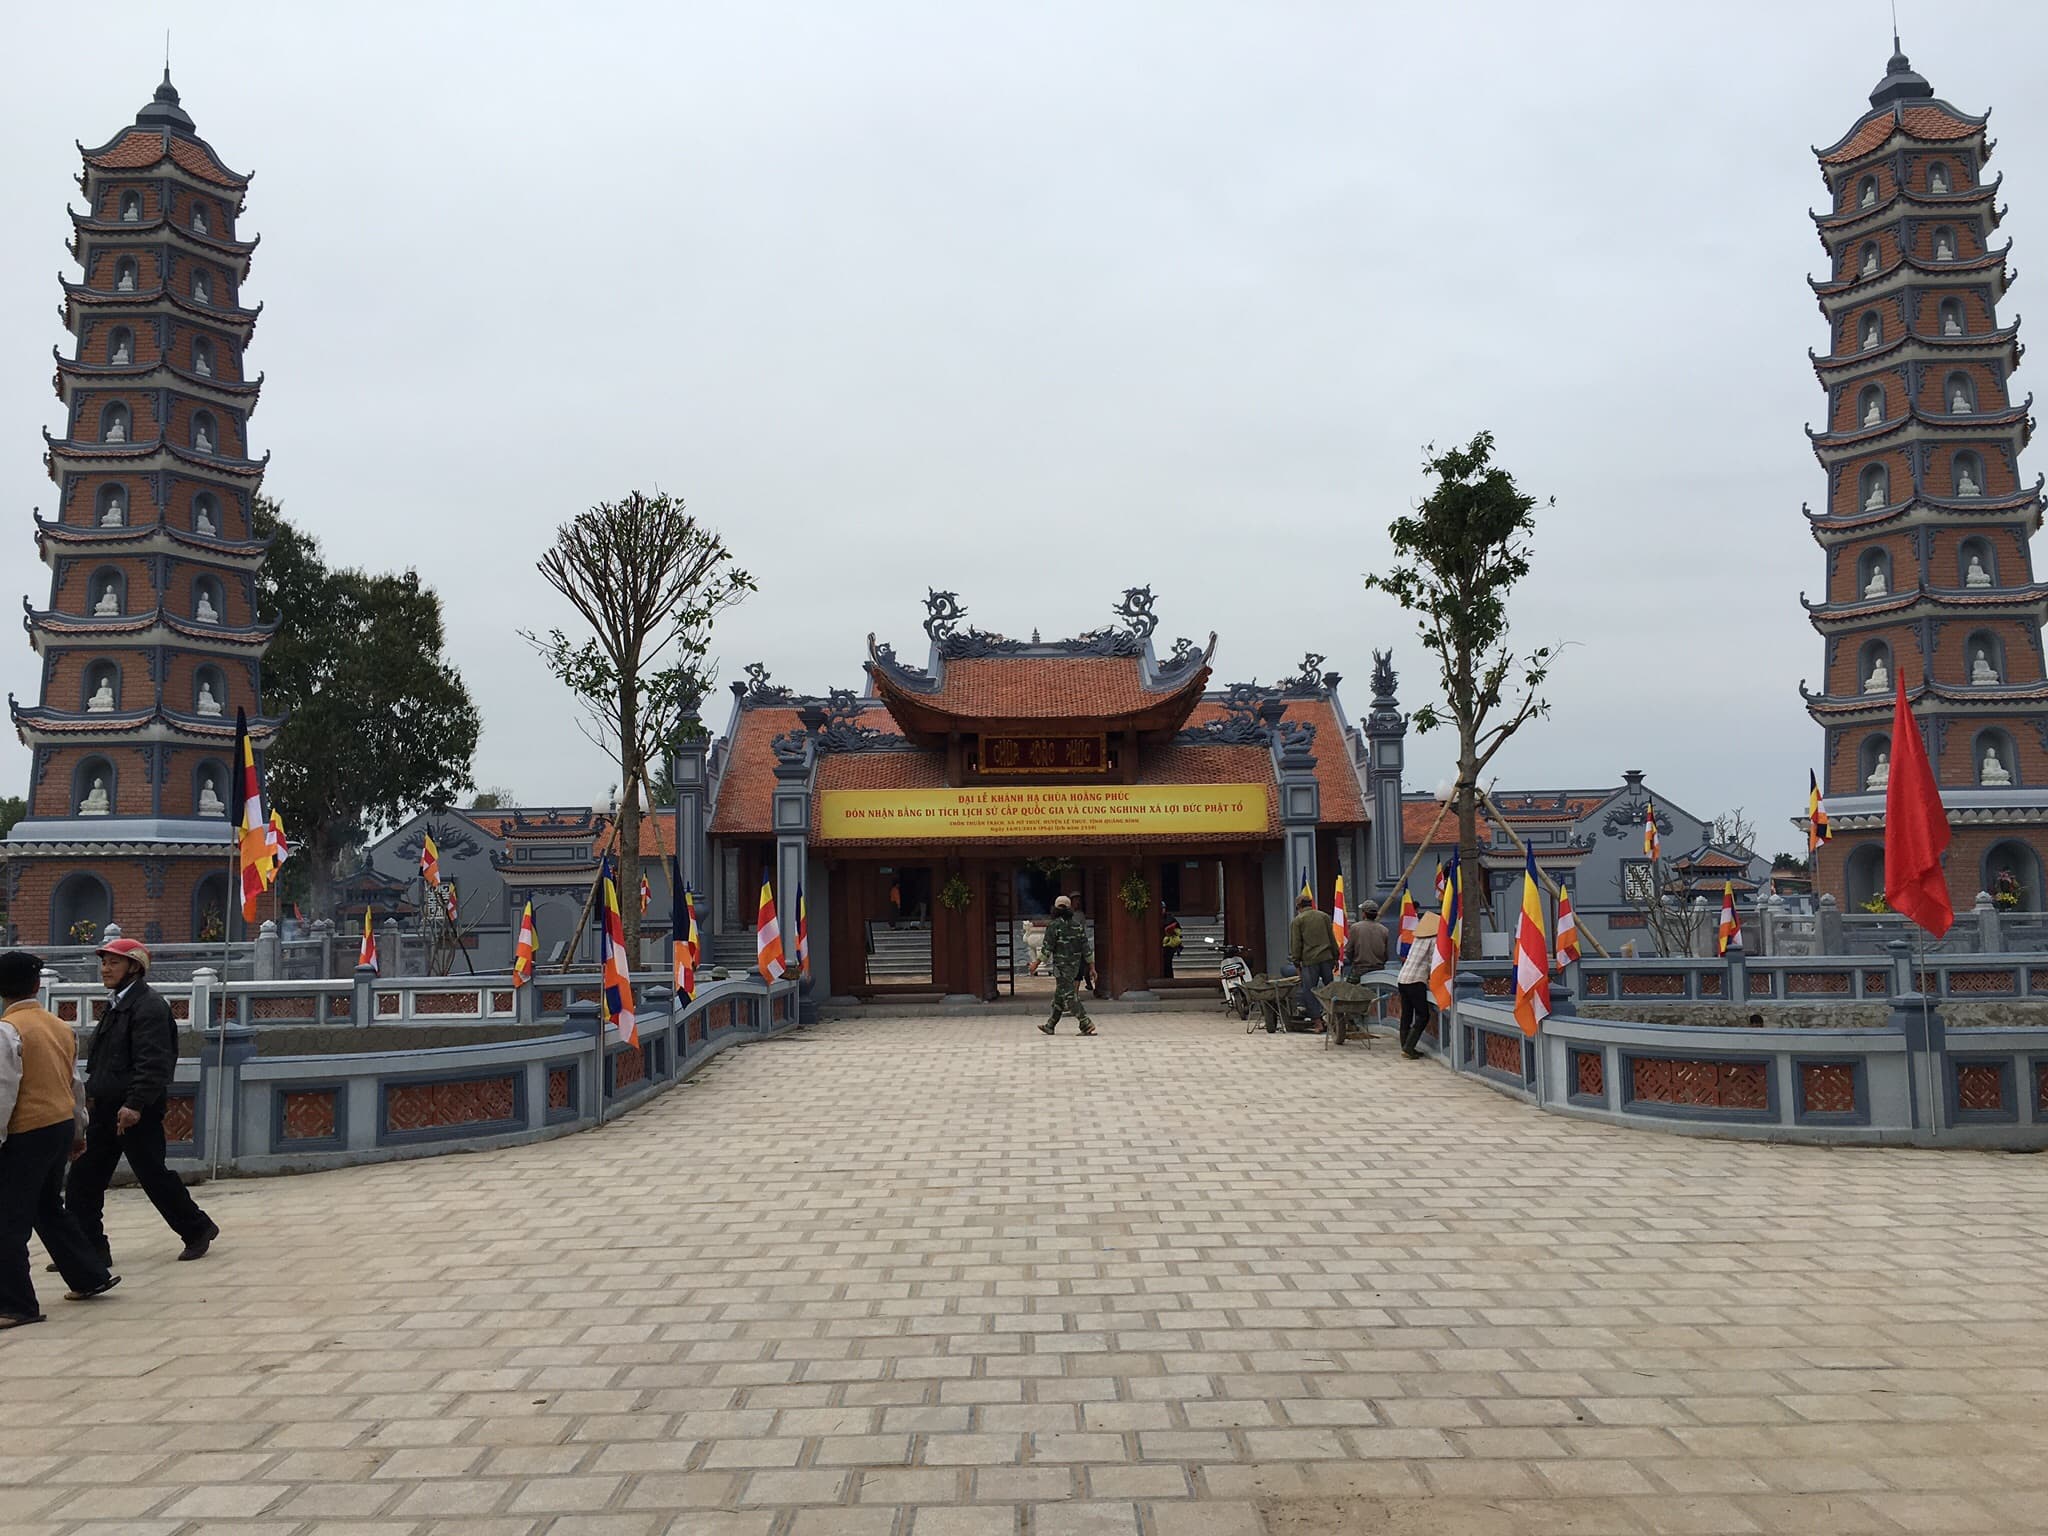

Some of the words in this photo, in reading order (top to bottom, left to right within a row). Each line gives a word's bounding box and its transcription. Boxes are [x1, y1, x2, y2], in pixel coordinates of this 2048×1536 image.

[958, 794, 974, 805] ĐẠI
[977, 791, 989, 803] LỄ
[991, 791, 1024, 802] KHÁNH
[1027, 793, 1040, 804] HẠ
[1042, 791, 1067, 801] CHÙA
[1105, 790, 1130, 800] PHÚC
[845, 808, 865, 818] ĐÓN
[868, 808, 894, 819] NHẬN
[897, 804, 922, 817] BẰNG
[925, 808, 936, 817] DI
[938, 806, 959, 816] TÍCH
[962, 808, 983, 818] LỊCH
[985, 805, 998, 816] SỬ
[1000, 803, 1018, 816] CẤP
[1020, 802, 1046, 816] QUỐC
[1048, 806, 1064, 815] GIA
[1067, 804, 1080, 815] VÀ
[1081, 806, 1107, 815] CUNG
[1109, 805, 1146, 814] NGHINH
[1149, 803, 1161, 814] XÁ
[1164, 804, 1180, 815] LỢI
[1183, 803, 1202, 813] ĐỨC
[1204, 803, 1229, 814] PHẬT
[1231, 800, 1243, 812] TỔ
